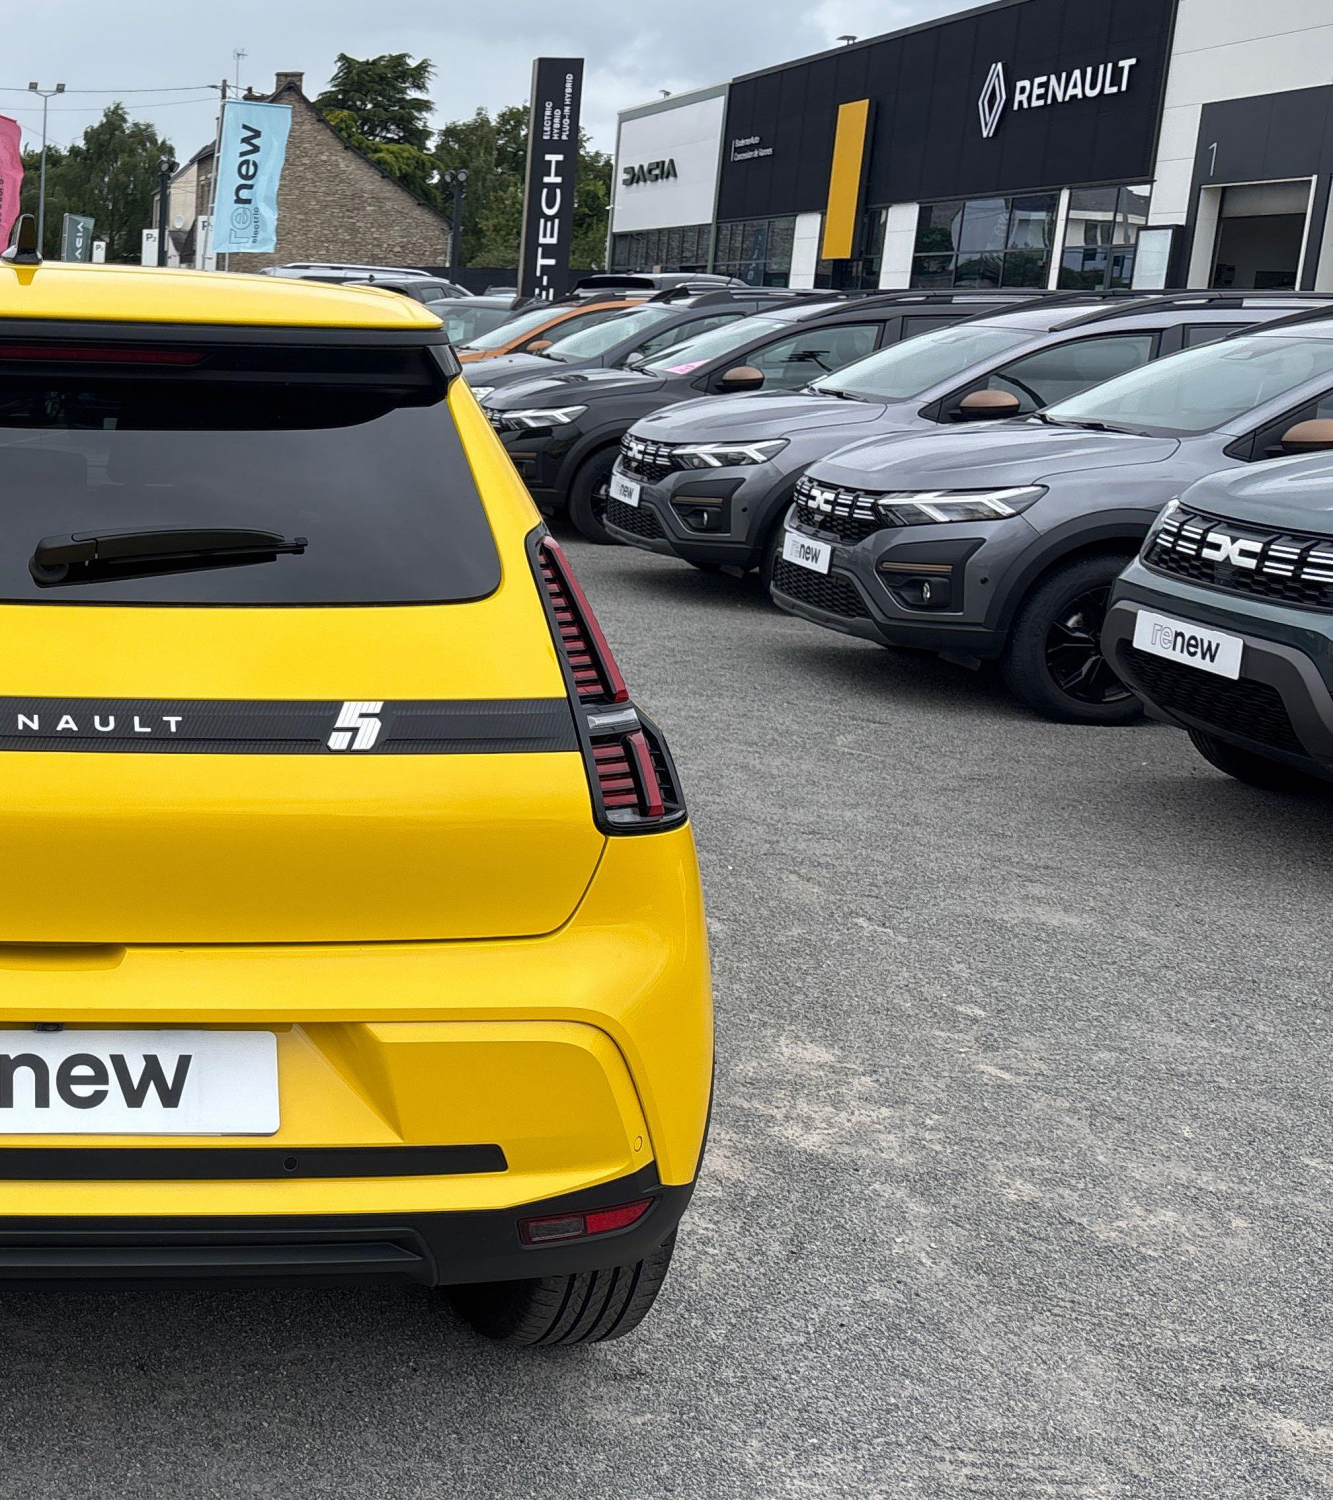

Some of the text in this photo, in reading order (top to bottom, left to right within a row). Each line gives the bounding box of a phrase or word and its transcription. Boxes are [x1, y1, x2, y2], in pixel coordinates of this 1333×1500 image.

[1013, 58, 1137, 111] RENAULT
[622, 158, 678, 187] DACIA
[1208, 142, 1218, 176] 1
[228, 123, 262, 244] renew
[251, 207, 260, 244] electric
[1151, 623, 1220, 663] renew
[327, 701, 384, 752] 5
